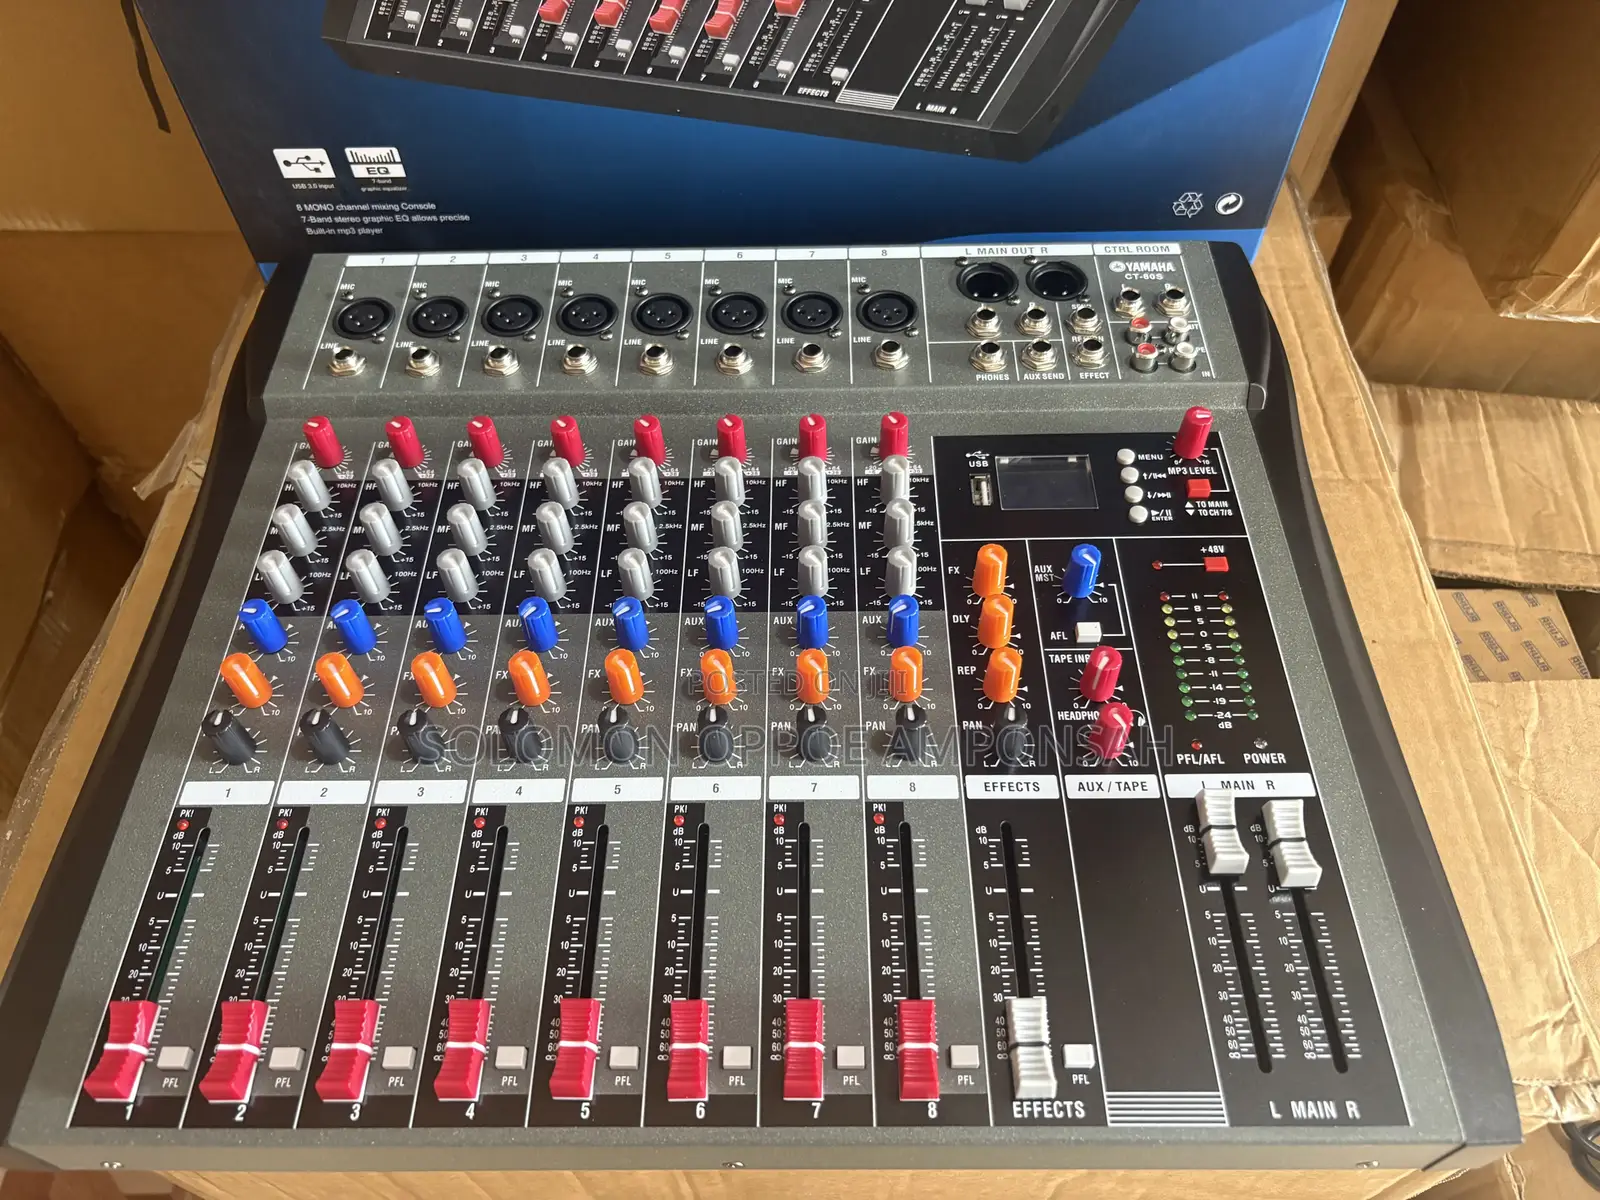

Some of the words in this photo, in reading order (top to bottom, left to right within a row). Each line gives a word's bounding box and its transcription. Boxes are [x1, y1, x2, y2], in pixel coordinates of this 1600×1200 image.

[798, 87, 829, 98] EFFECTS
[926, 104, 947, 114] MAIN
[366, 166, 390, 175] EQ
[296, 204, 303, 212] 8
[304, 204, 334, 212] MONO
[336, 203, 370, 211] channel
[371, 203, 400, 212] mixing
[400, 202, 436, 210] Console
[301, 216, 332, 224] 7-Band
[362, 216, 394, 225] graphic
[394, 214, 410, 222] EQ
[411, 214, 438, 222] allows
[440, 214, 470, 223] precise
[306, 228, 336, 236] Built-in
[337, 228, 356, 236] mp3
[358, 228, 383, 236] player
[966, 248, 972, 256] L
[976, 247, 1008, 256] MAIN
[1011, 247, 1034, 255] OUT
[1041, 246, 1048, 254] R
[1104, 246, 1133, 254] CTRL
[1135, 245, 1171, 253] ROOM
[1124, 262, 1176, 272] YAMAHA
[976, 373, 1010, 381] PHONES
[1043, 372, 1065, 380] SEND
[1079, 372, 1110, 380] EFFECT
[856, 436, 877, 444] GAIN
[1168, 466, 1187, 475] MP3
[1189, 466, 1217, 475] LEVEL
[530, 481, 542, 489] HF
[1200, 545, 1224, 554] +48V
[774, 568, 785, 576] LF
[948, 566, 960, 574] FX
[1034, 565, 1053, 573] AUX
[514, 570, 525, 578] LF
[1035, 574, 1054, 582] MST
[773, 616, 793, 625] AUX
[862, 615, 882, 624] AUX
[952, 615, 970, 623] DLY
[1050, 632, 1068, 640] AFL
[1049, 654, 1072, 663] TAPE
[588, 669, 601, 678] FX
[864, 667, 876, 676] FX
[958, 666, 976, 675] REP
[676, 723, 697, 732] PAN
[866, 721, 886, 731] PAN
[963, 721, 983, 730] PAN
[1218, 721, 1233, 729] dB
[1177, 753, 1225, 765] PFL/AFL
[1244, 753, 1286, 764] POWER
[712, 783, 720, 793] 6
[811, 783, 818, 793] 7
[909, 782, 916, 792] 8
[984, 782, 1040, 792] EFFECTS
[1077, 782, 1105, 792] AUX
[1115, 781, 1148, 792] TAPE
[1221, 781, 1255, 790] MAIN
[1266, 780, 1275, 790] R
[320, 788, 328, 797] 2
[417, 787, 425, 797] 3
[515, 786, 523, 796] 4
[614, 785, 622, 795] 5
[873, 804, 886, 812] PK!
[180, 809, 194, 818] PK!
[874, 826, 885, 834] dB
[976, 826, 987, 834] dB
[173, 832, 185, 840] dB
[172, 842, 181, 850] 10
[880, 886, 887, 895] U
[157, 891, 164, 900] U
[1212, 964, 1223, 972] 20
[128, 970, 139, 978] 20
[993, 993, 1003, 1002] 30
[1223, 1015, 1233, 1023] 40
[1228, 1041, 1238, 1049] 60
[162, 1077, 179, 1088] PFL
[615, 1076, 631, 1086] PFL
[958, 1075, 974, 1085] PFL
[1072, 1074, 1090, 1084] PFL
[125, 1104, 134, 1120] 1
[235, 1105, 247, 1122] 2
[350, 1104, 361, 1121] 3
[465, 1103, 475, 1120] 4
[580, 1102, 590, 1119] 5
[696, 1102, 706, 1119] 6
[811, 1102, 821, 1118] 7
[928, 1102, 937, 1118] 8
[1012, 1101, 1086, 1118] EFFECTS
[1269, 1100, 1283, 1119] L
[1290, 1100, 1337, 1119] MAIN
[1345, 1100, 1361, 1119] R
